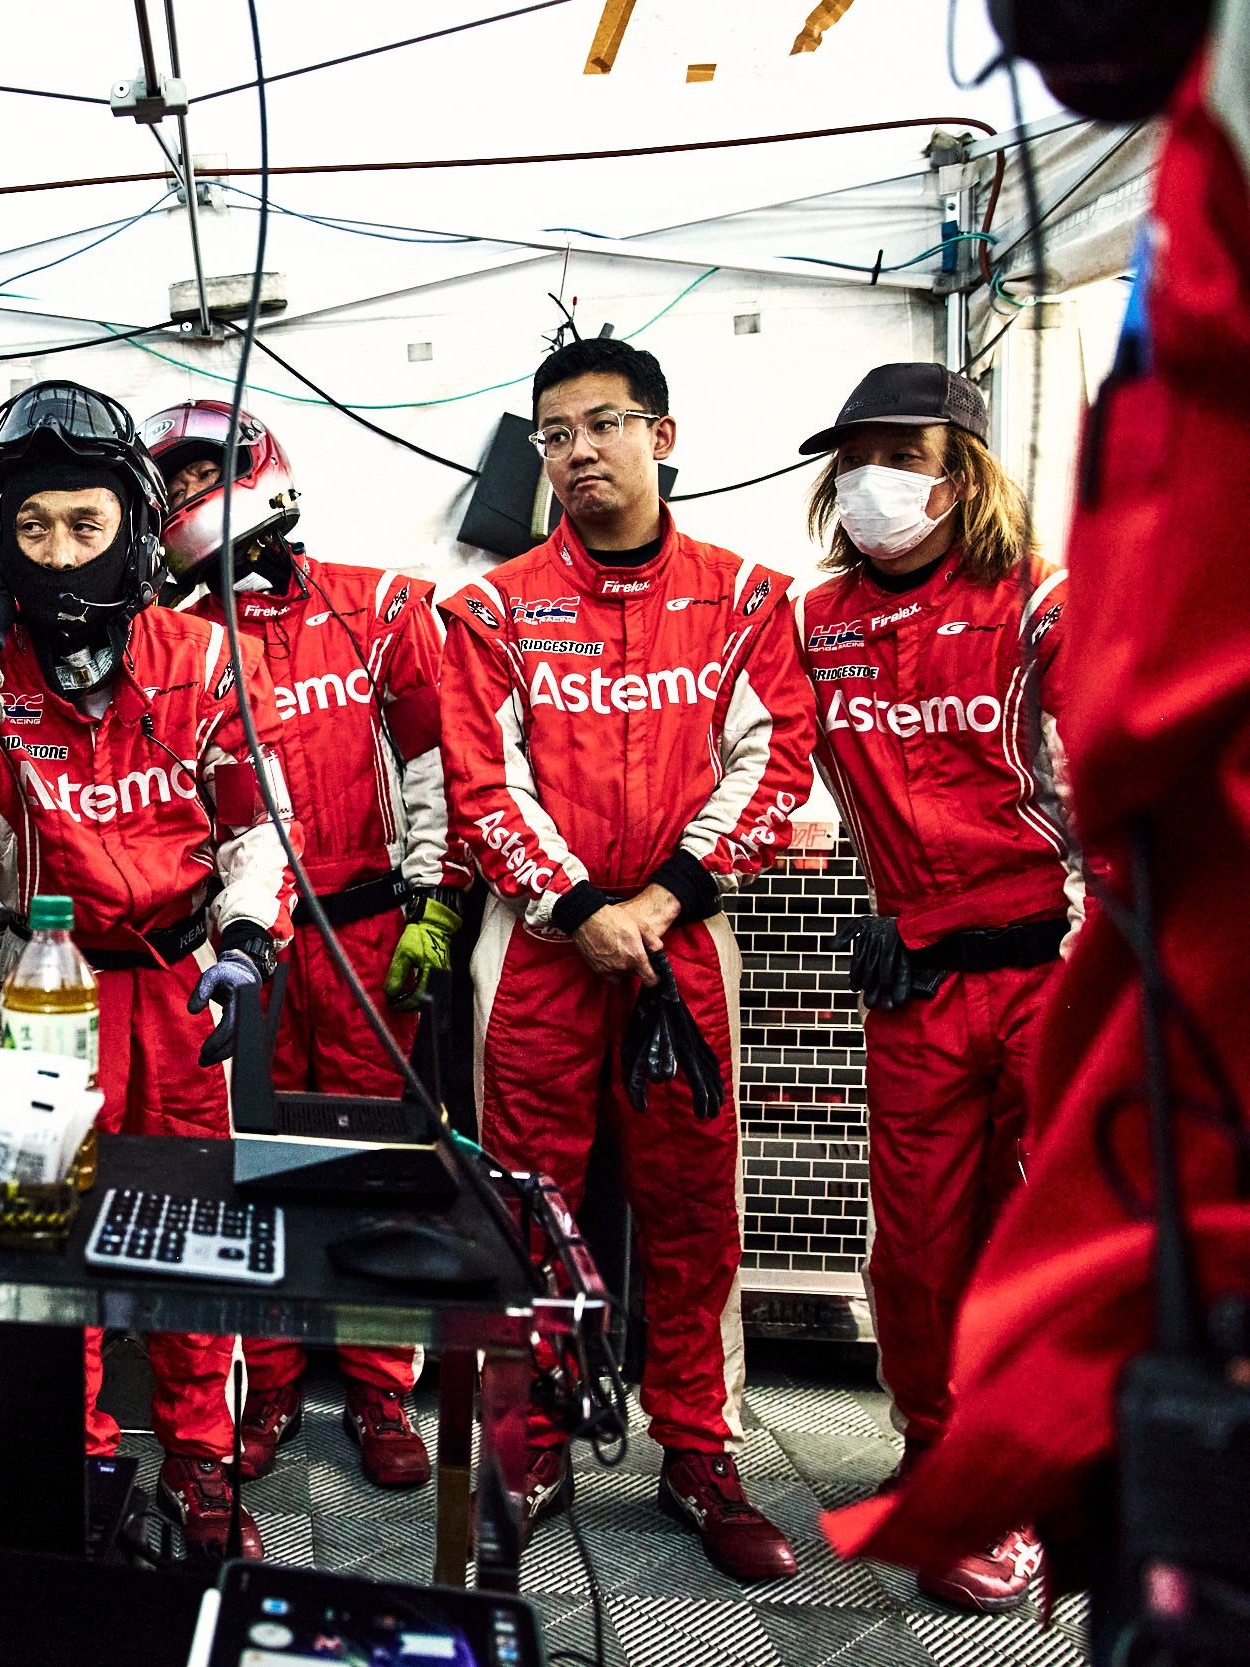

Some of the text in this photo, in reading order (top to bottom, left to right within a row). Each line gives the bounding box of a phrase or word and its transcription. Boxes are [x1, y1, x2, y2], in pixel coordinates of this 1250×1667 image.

[510, 596, 580, 619] HRC
[808, 620, 864, 648] HRC
[274, 668, 372, 721] emo
[530, 661, 722, 715] Astemo
[825, 690, 1001, 739] Astemo
[20, 760, 198, 823] Atemo
